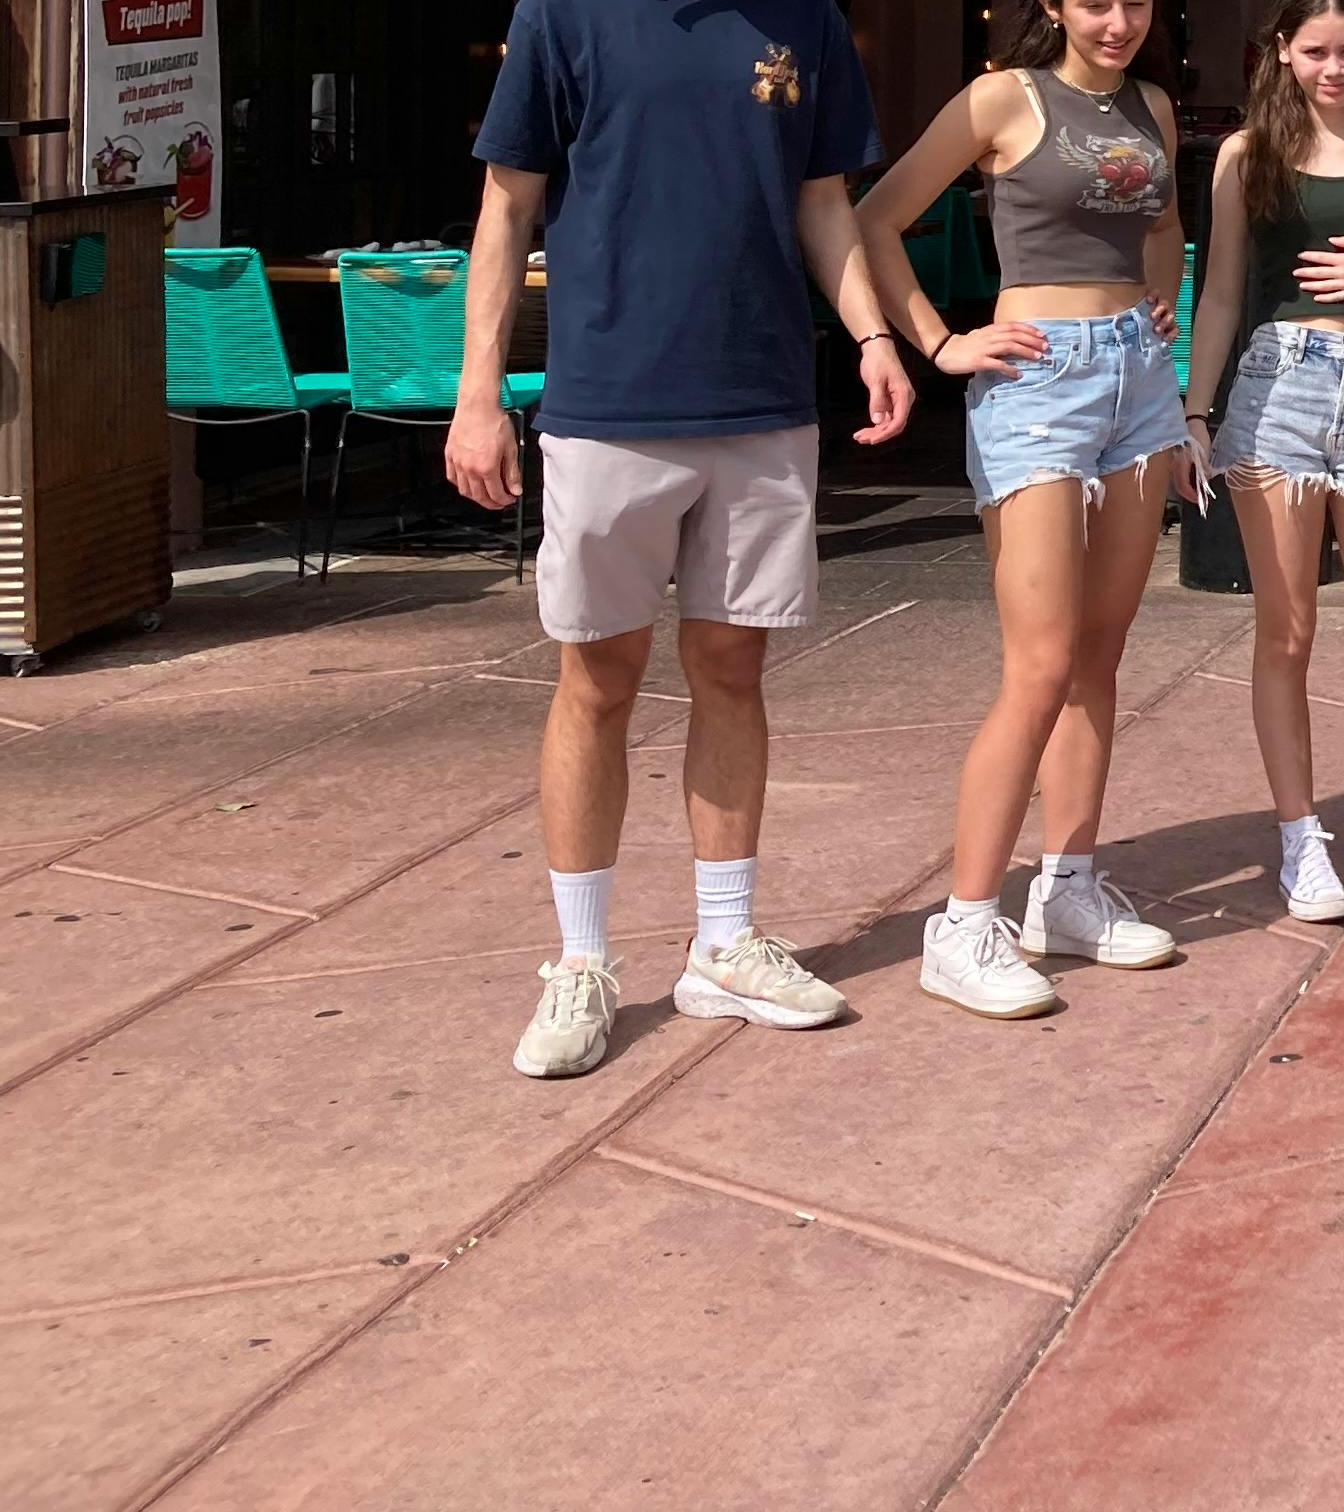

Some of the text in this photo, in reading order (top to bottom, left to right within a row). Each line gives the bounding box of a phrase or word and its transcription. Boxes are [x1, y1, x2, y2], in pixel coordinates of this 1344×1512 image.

[120, 0, 165, 35] Tequila
[116, 51, 199, 82] TEQUILA MARGARITAS
[118, 75, 194, 104] with natural fresh
[123, 100, 185, 126] fruit popsicles
